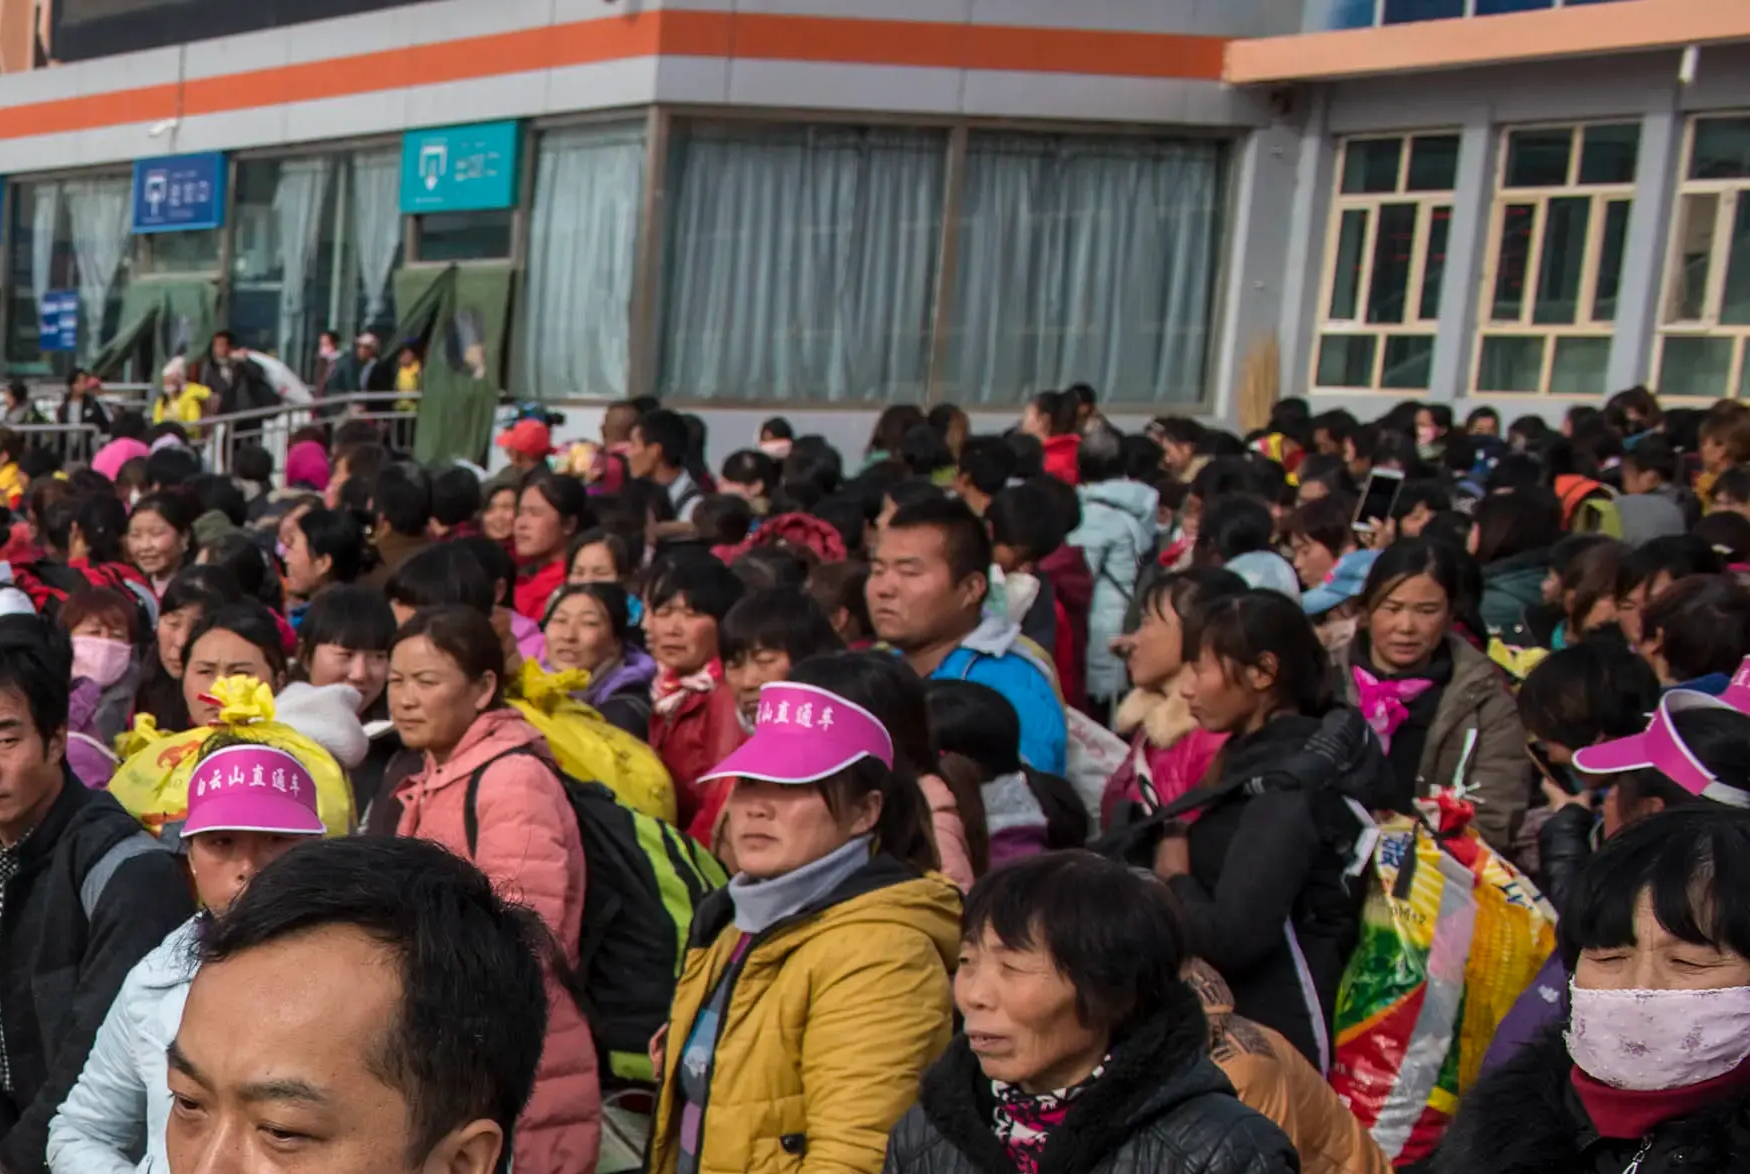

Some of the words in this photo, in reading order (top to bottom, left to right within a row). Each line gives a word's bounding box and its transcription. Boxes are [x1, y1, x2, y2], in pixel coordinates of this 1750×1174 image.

[196, 763, 301, 798] 白云山直通车
